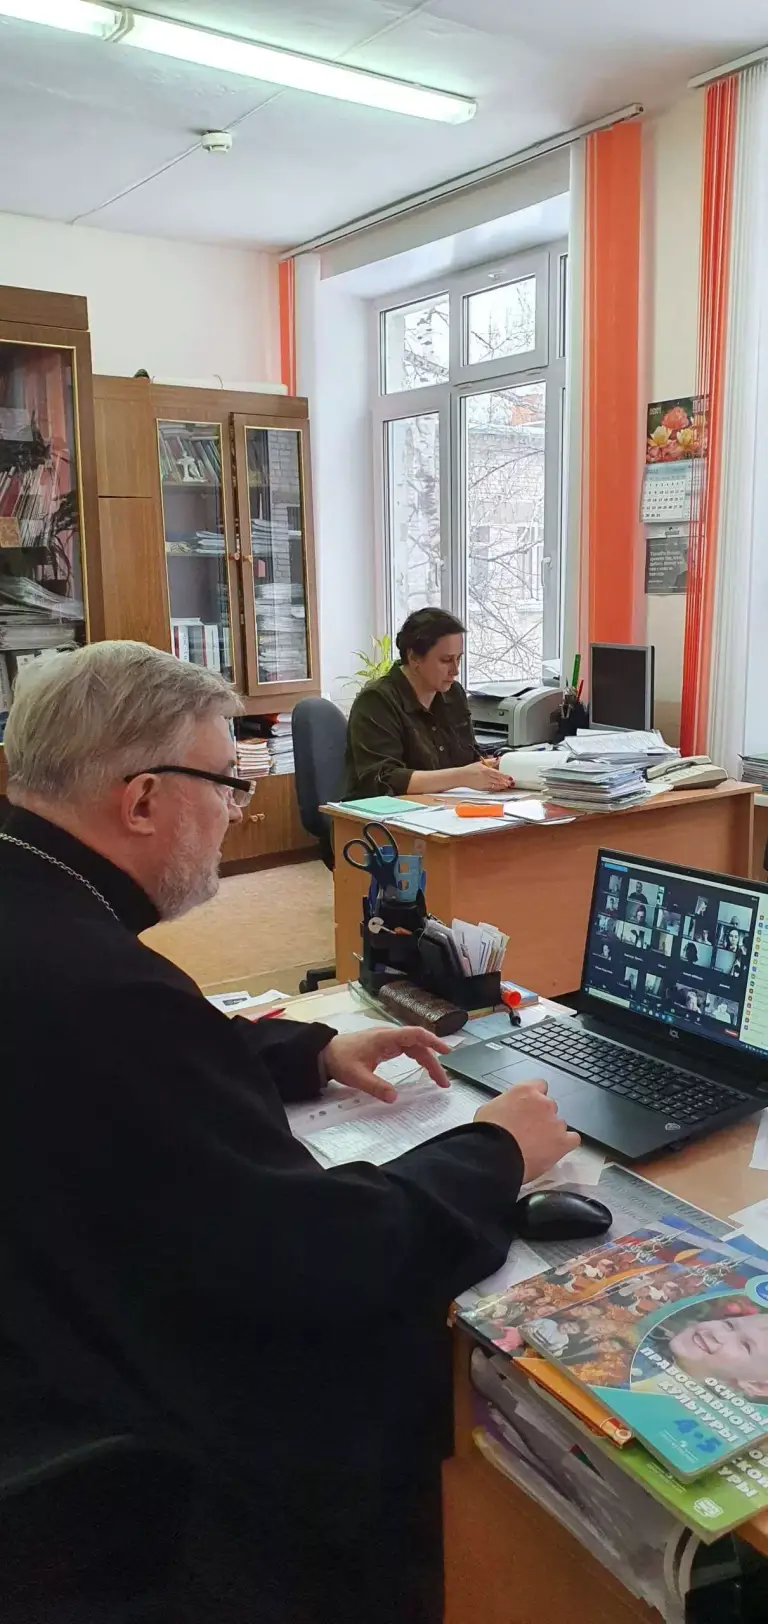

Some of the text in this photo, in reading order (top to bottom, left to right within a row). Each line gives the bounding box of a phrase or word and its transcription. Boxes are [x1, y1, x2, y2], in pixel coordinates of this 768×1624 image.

[639, 1346, 756, 1434] ПРАВОСЛАВНОЙ
[657, 1380, 739, 1443] КУЛЬТУРЫ
[704, 1377, 768, 1426] ОСНОВЫ
[718, 1466, 758, 1498] УРЫ
